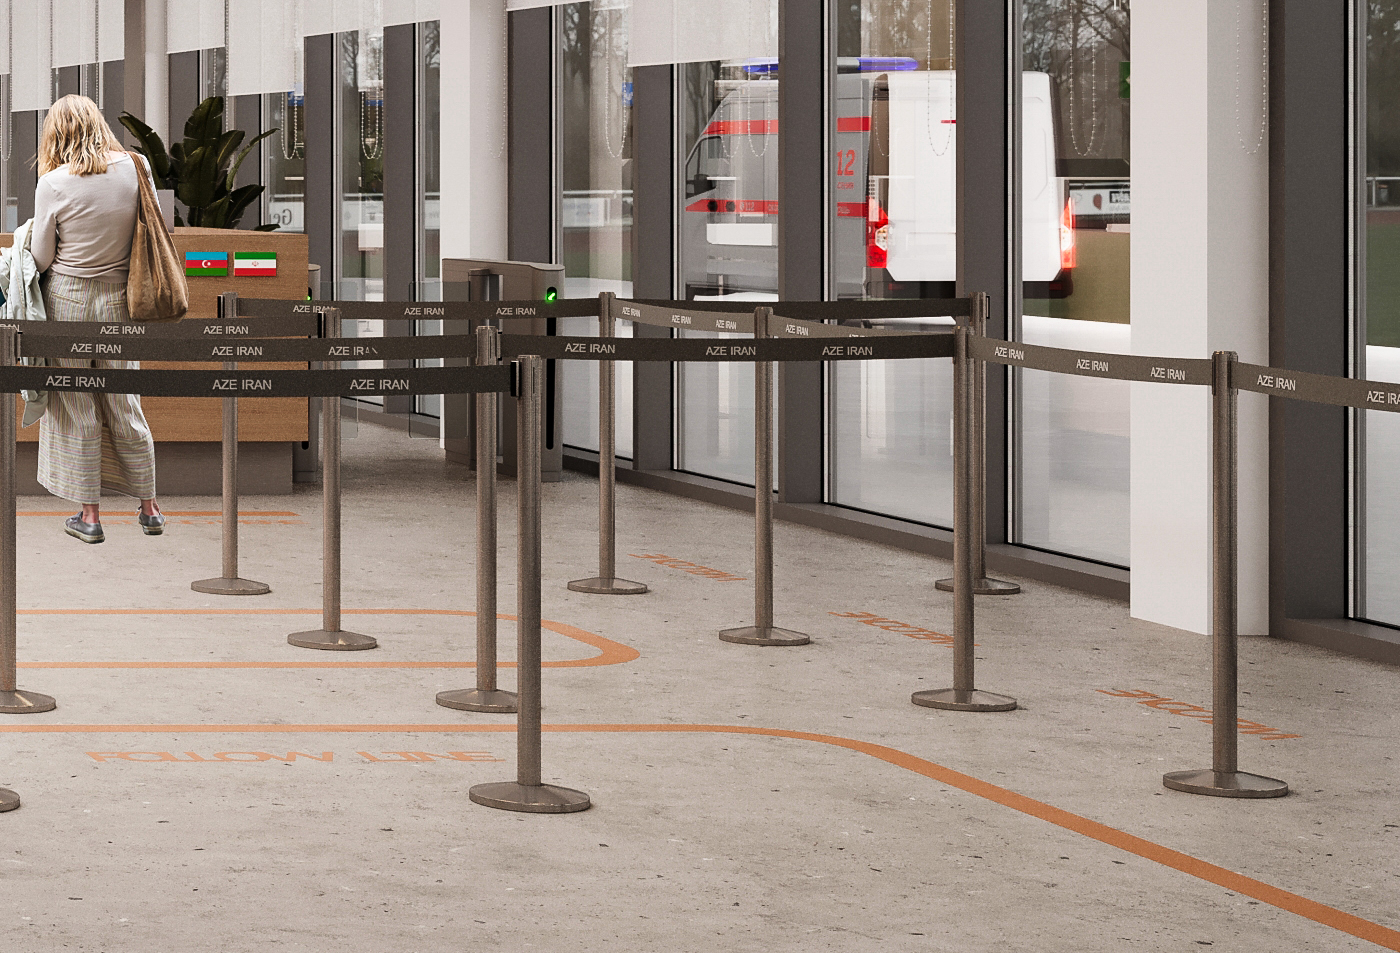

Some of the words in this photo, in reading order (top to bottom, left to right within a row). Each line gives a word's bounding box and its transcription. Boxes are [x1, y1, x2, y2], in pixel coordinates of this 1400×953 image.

[293, 305, 309, 313] AZE
[404, 308, 421, 316] AZE
[424, 308, 444, 316] IRAN
[496, 308, 513, 316] AZE
[516, 308, 536, 316] IRAN
[622, 307, 630, 316] AZE
[631, 308, 640, 317] IRAN
[672, 315, 680, 324] AZE
[681, 315, 691, 325] IRAN
[716, 320, 725, 328] AZE
[726, 320, 736, 330] IRAN
[100, 326, 119, 334] AZE
[122, 326, 145, 334] IRAN
[204, 326, 222, 334] AZE
[226, 326, 248, 334] IRAN
[786, 324, 796, 334] AZE
[797, 325, 809, 336] IRAN
[71, 343, 92, 353] AZE
[96, 344, 121, 354] IRAN
[212, 347, 233, 356] AZE
[237, 346, 262, 356] IRAN
[329, 347, 350, 356] AZE
[565, 343, 586, 352] AZE
[590, 343, 615, 354] IRAN
[706, 347, 727, 356] AZE
[731, 347, 756, 356] IRAN
[822, 347, 843, 356] AZE
[847, 347, 872, 356] IRAN
[995, 347, 1007, 358] AZE
[1009, 348, 1024, 361] IRAN
[1076, 359, 1091, 370] AZE
[1092, 360, 1109, 372] IRAN
[1150, 367, 1165, 379] AZE
[1167, 368, 1186, 381] IRAN
[46, 376, 71, 386] AZE
[76, 377, 105, 388] IRAN
[212, 380, 237, 390] AZE
[242, 380, 272, 390] IRAN
[350, 380, 375, 390] AZE
[380, 380, 409, 390] IRAN
[1257, 374, 1274, 388] AZE
[1276, 376, 1296, 391] IRAN
[1367, 391, 1384, 404] AZE
[1388, 391, 1400, 404] IRA
